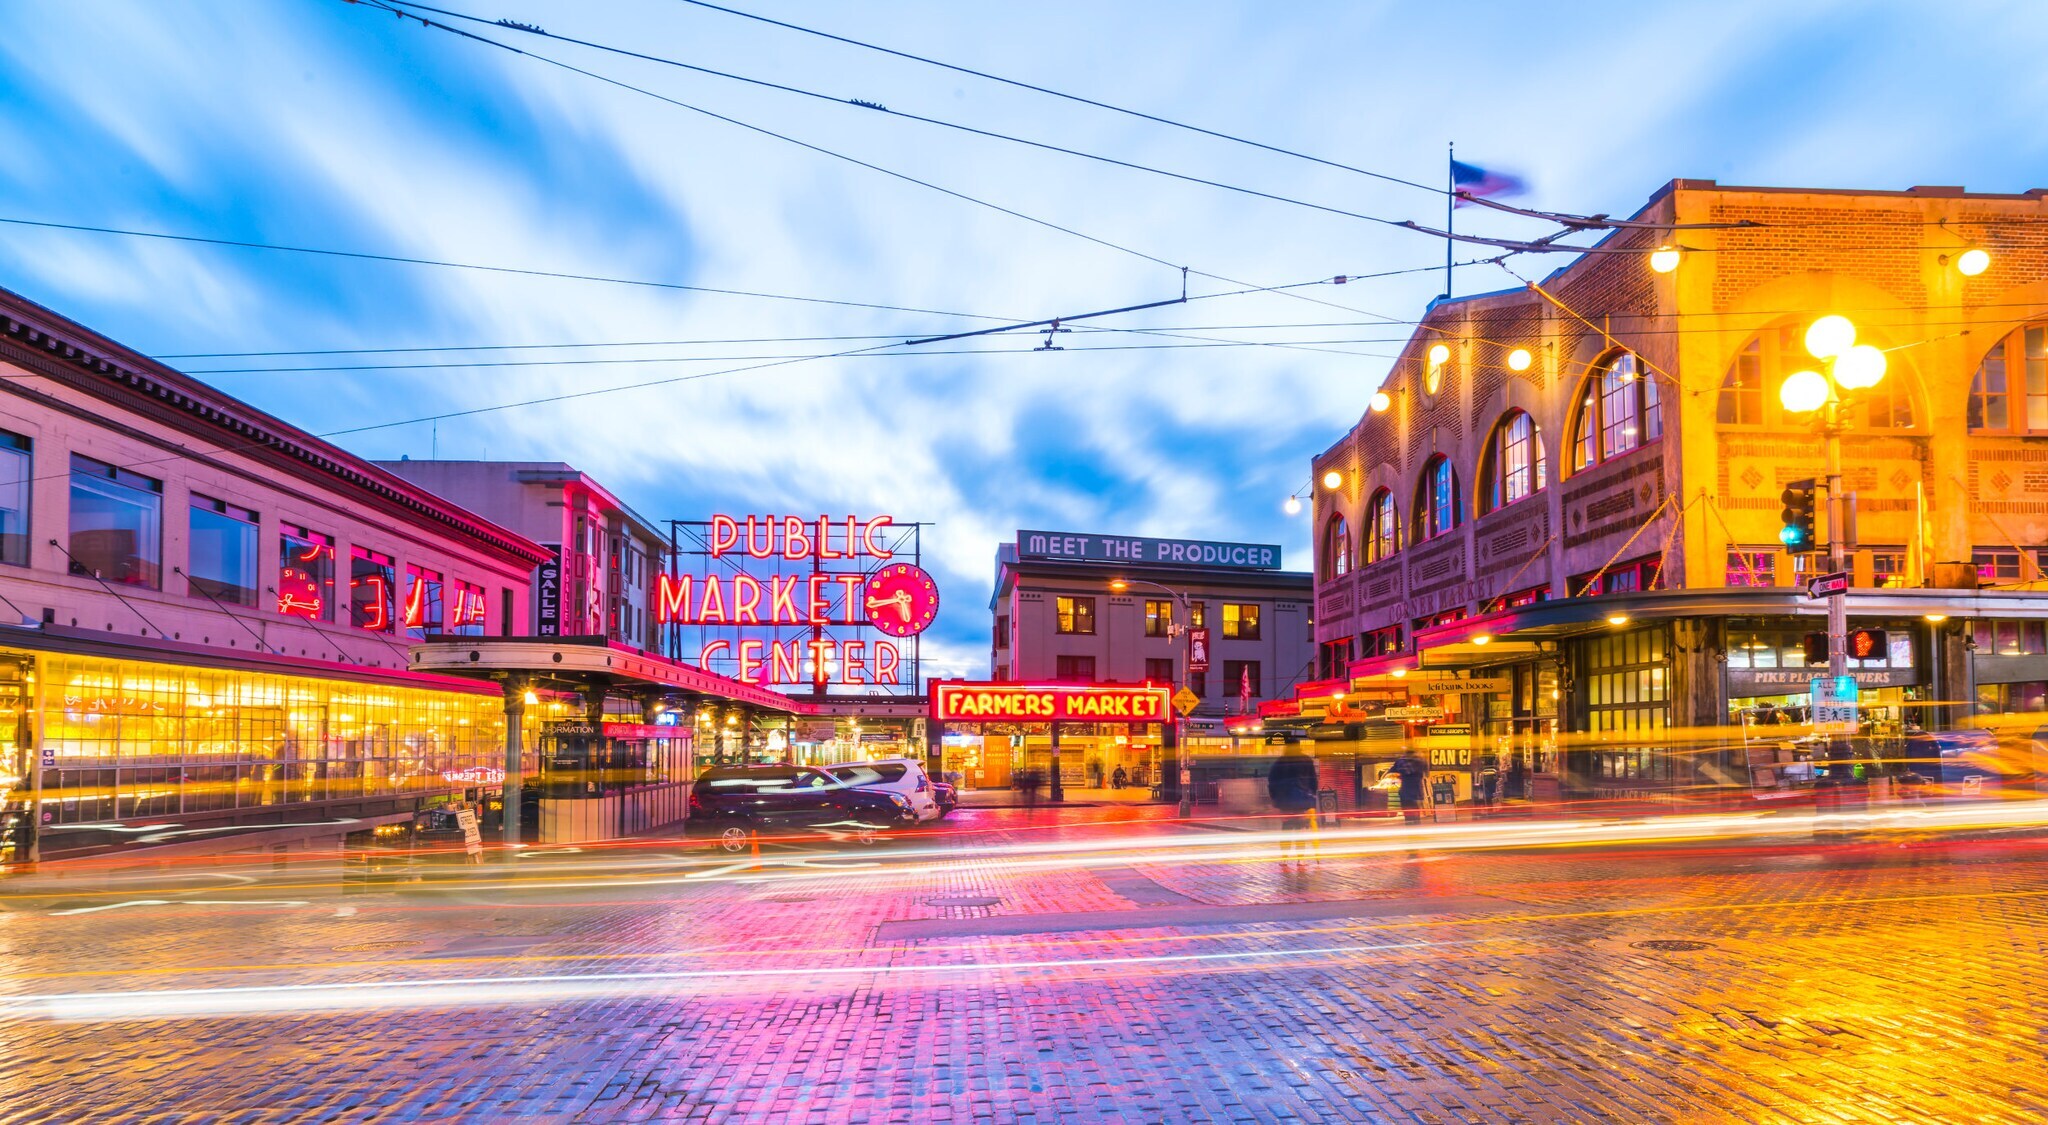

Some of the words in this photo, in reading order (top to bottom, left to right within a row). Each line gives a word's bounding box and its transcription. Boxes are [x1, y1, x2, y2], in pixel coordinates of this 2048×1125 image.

[712, 514, 893, 560] PUBLIC
[1029, 535, 1089, 556] MEET
[1102, 539, 1142, 559] THE
[1157, 543, 1272, 565] PRODUCER
[897, 566, 907, 574] 12
[1820, 582, 1831, 591] ONE
[541, 569, 557, 618] SALLE
[657, 574, 864, 625] MARKET
[929, 596, 935, 604] 3
[1389, 594, 1434, 624] CORNER
[1438, 576, 1495, 610] MARKET
[872, 611, 879, 619] 8
[924, 611, 931, 619] 4
[897, 626, 905, 634] 6
[914, 622, 921, 630] 5
[700, 640, 899, 686] CENTER
[1755, 672, 1786, 683] PIKE
[1466, 682, 1494, 690] books
[949, 693, 1055, 715] FARMERS
[1066, 695, 1159, 717] MARKET
[1431, 750, 1455, 765] CAN
